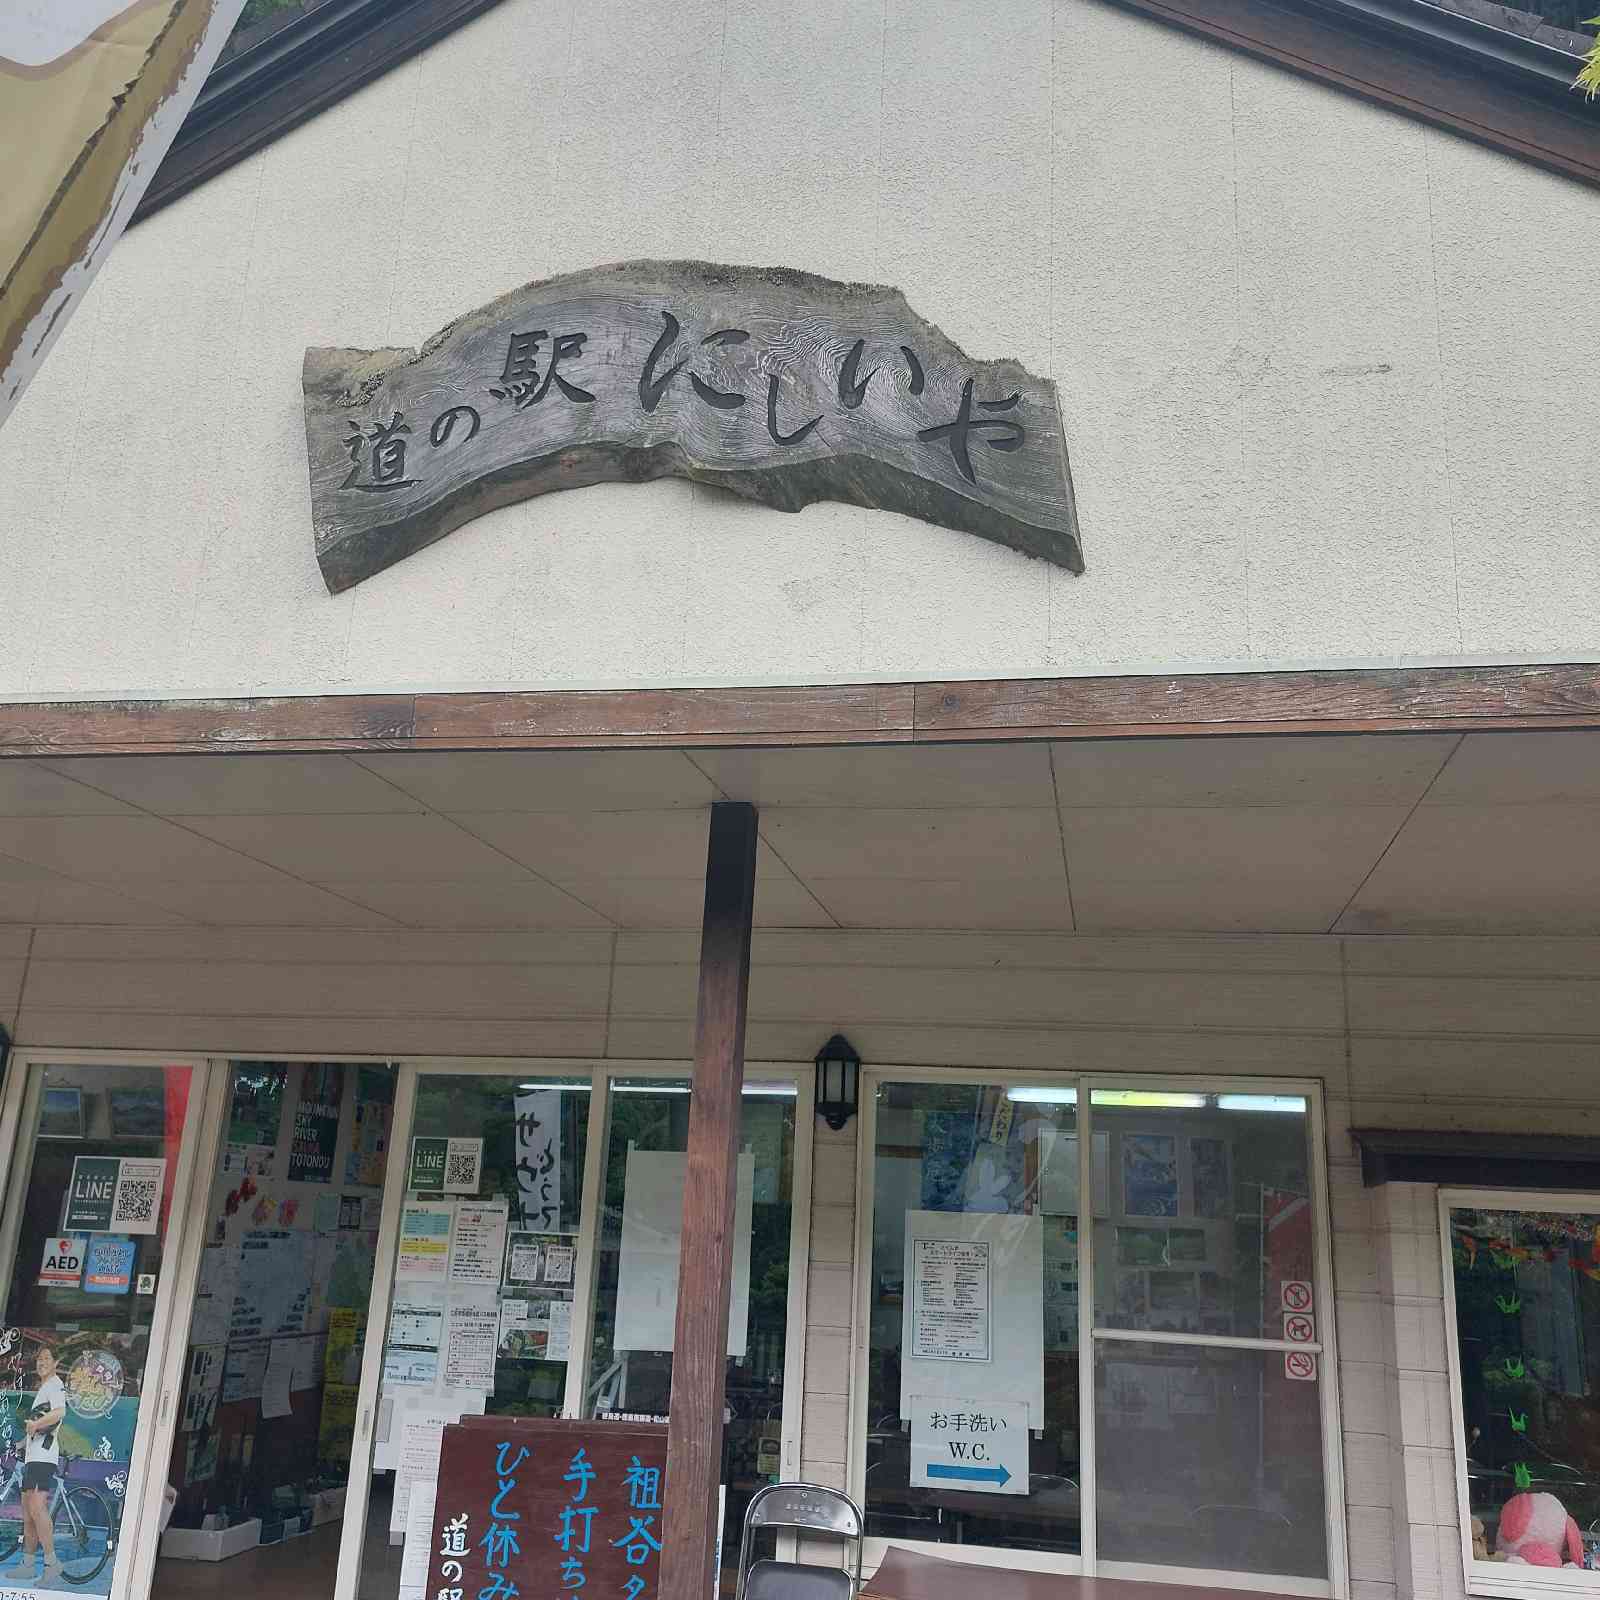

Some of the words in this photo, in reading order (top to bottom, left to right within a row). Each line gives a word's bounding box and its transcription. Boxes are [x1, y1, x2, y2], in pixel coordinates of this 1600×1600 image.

[341, 330, 595, 491] 道の駅
[640, 311, 1025, 485] にしいや
[417, 1155, 444, 1168] LINE
[75, 1181, 113, 1199] LINE
[45, 1256, 79, 1270] AED
[930, 1411, 1007, 1433] お手洗い
[948, 1441, 990, 1461] W.C.
[478, 1441, 530, 1600] ひと休み
[554, 1448, 599, 1600] 手打ち
